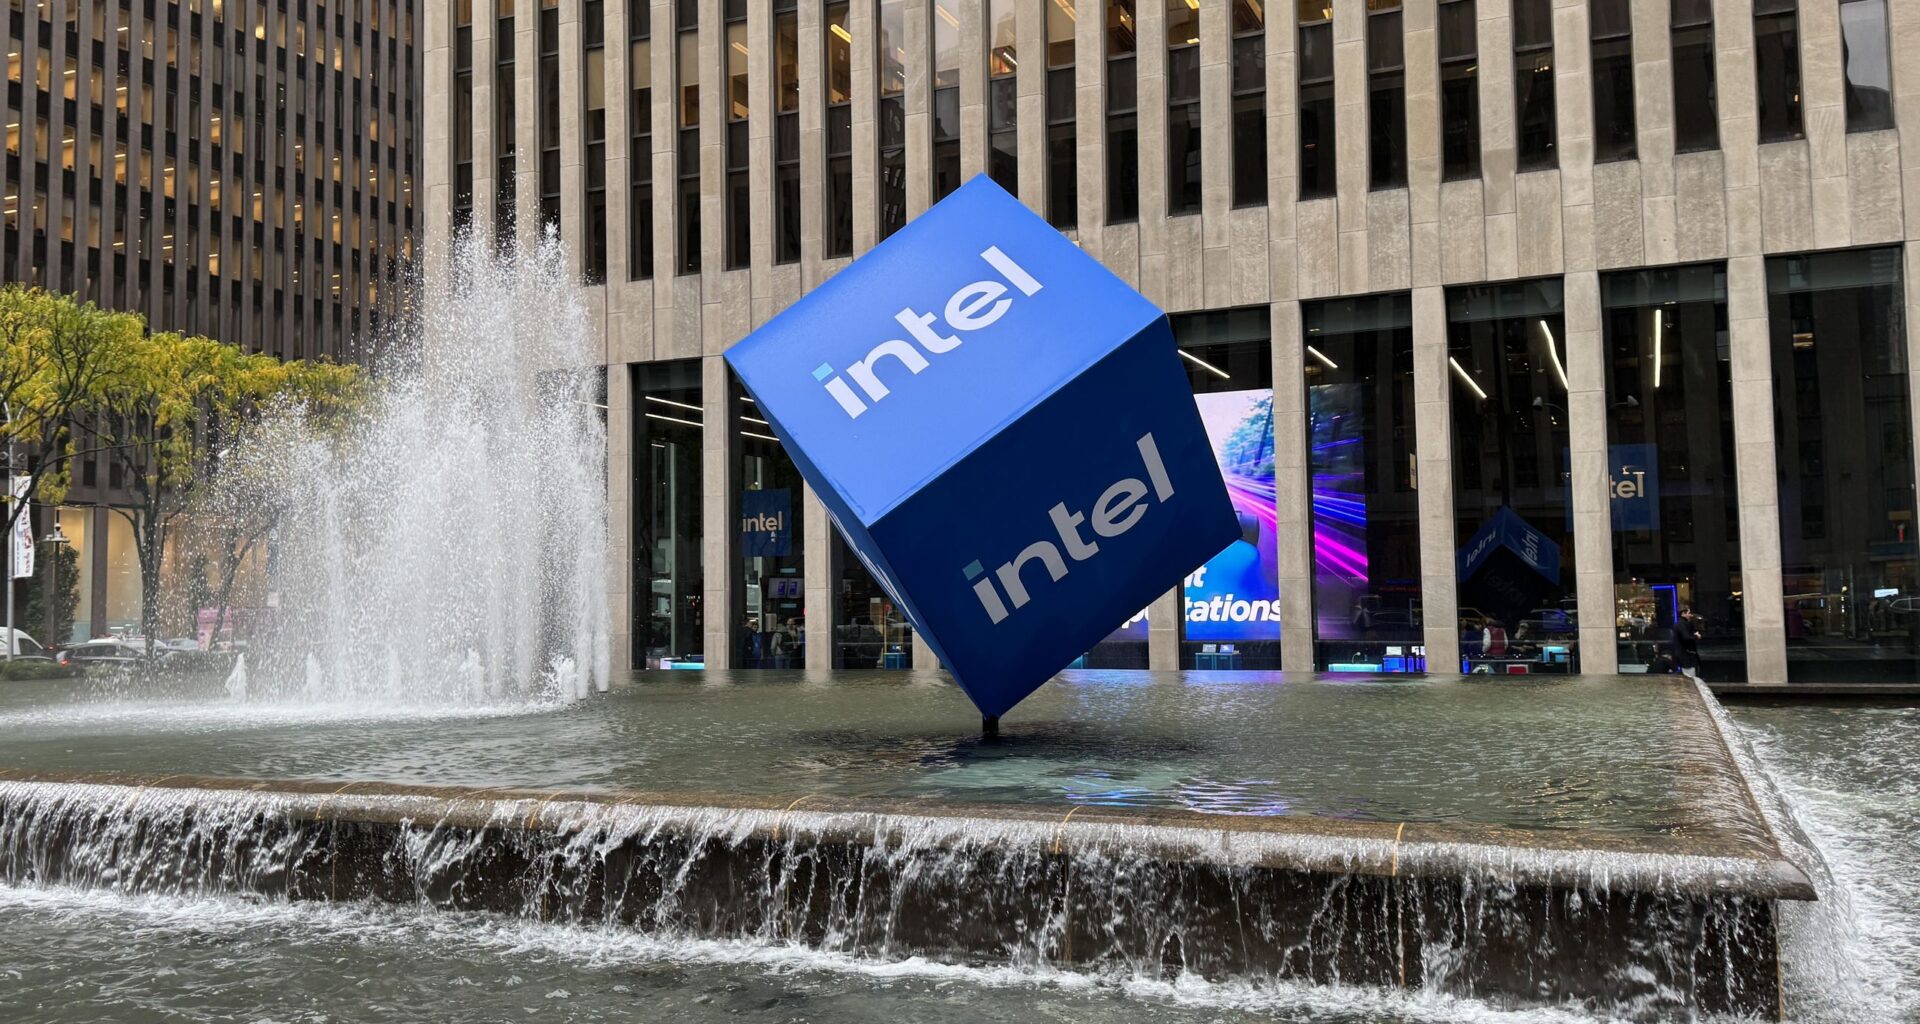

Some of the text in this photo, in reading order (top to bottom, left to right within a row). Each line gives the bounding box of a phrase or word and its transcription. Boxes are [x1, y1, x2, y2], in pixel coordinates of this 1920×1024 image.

[812, 245, 1044, 419] intel
[742, 510, 783, 532] intel
[962, 431, 1175, 625] intel
[1609, 471, 1645, 498] tel
